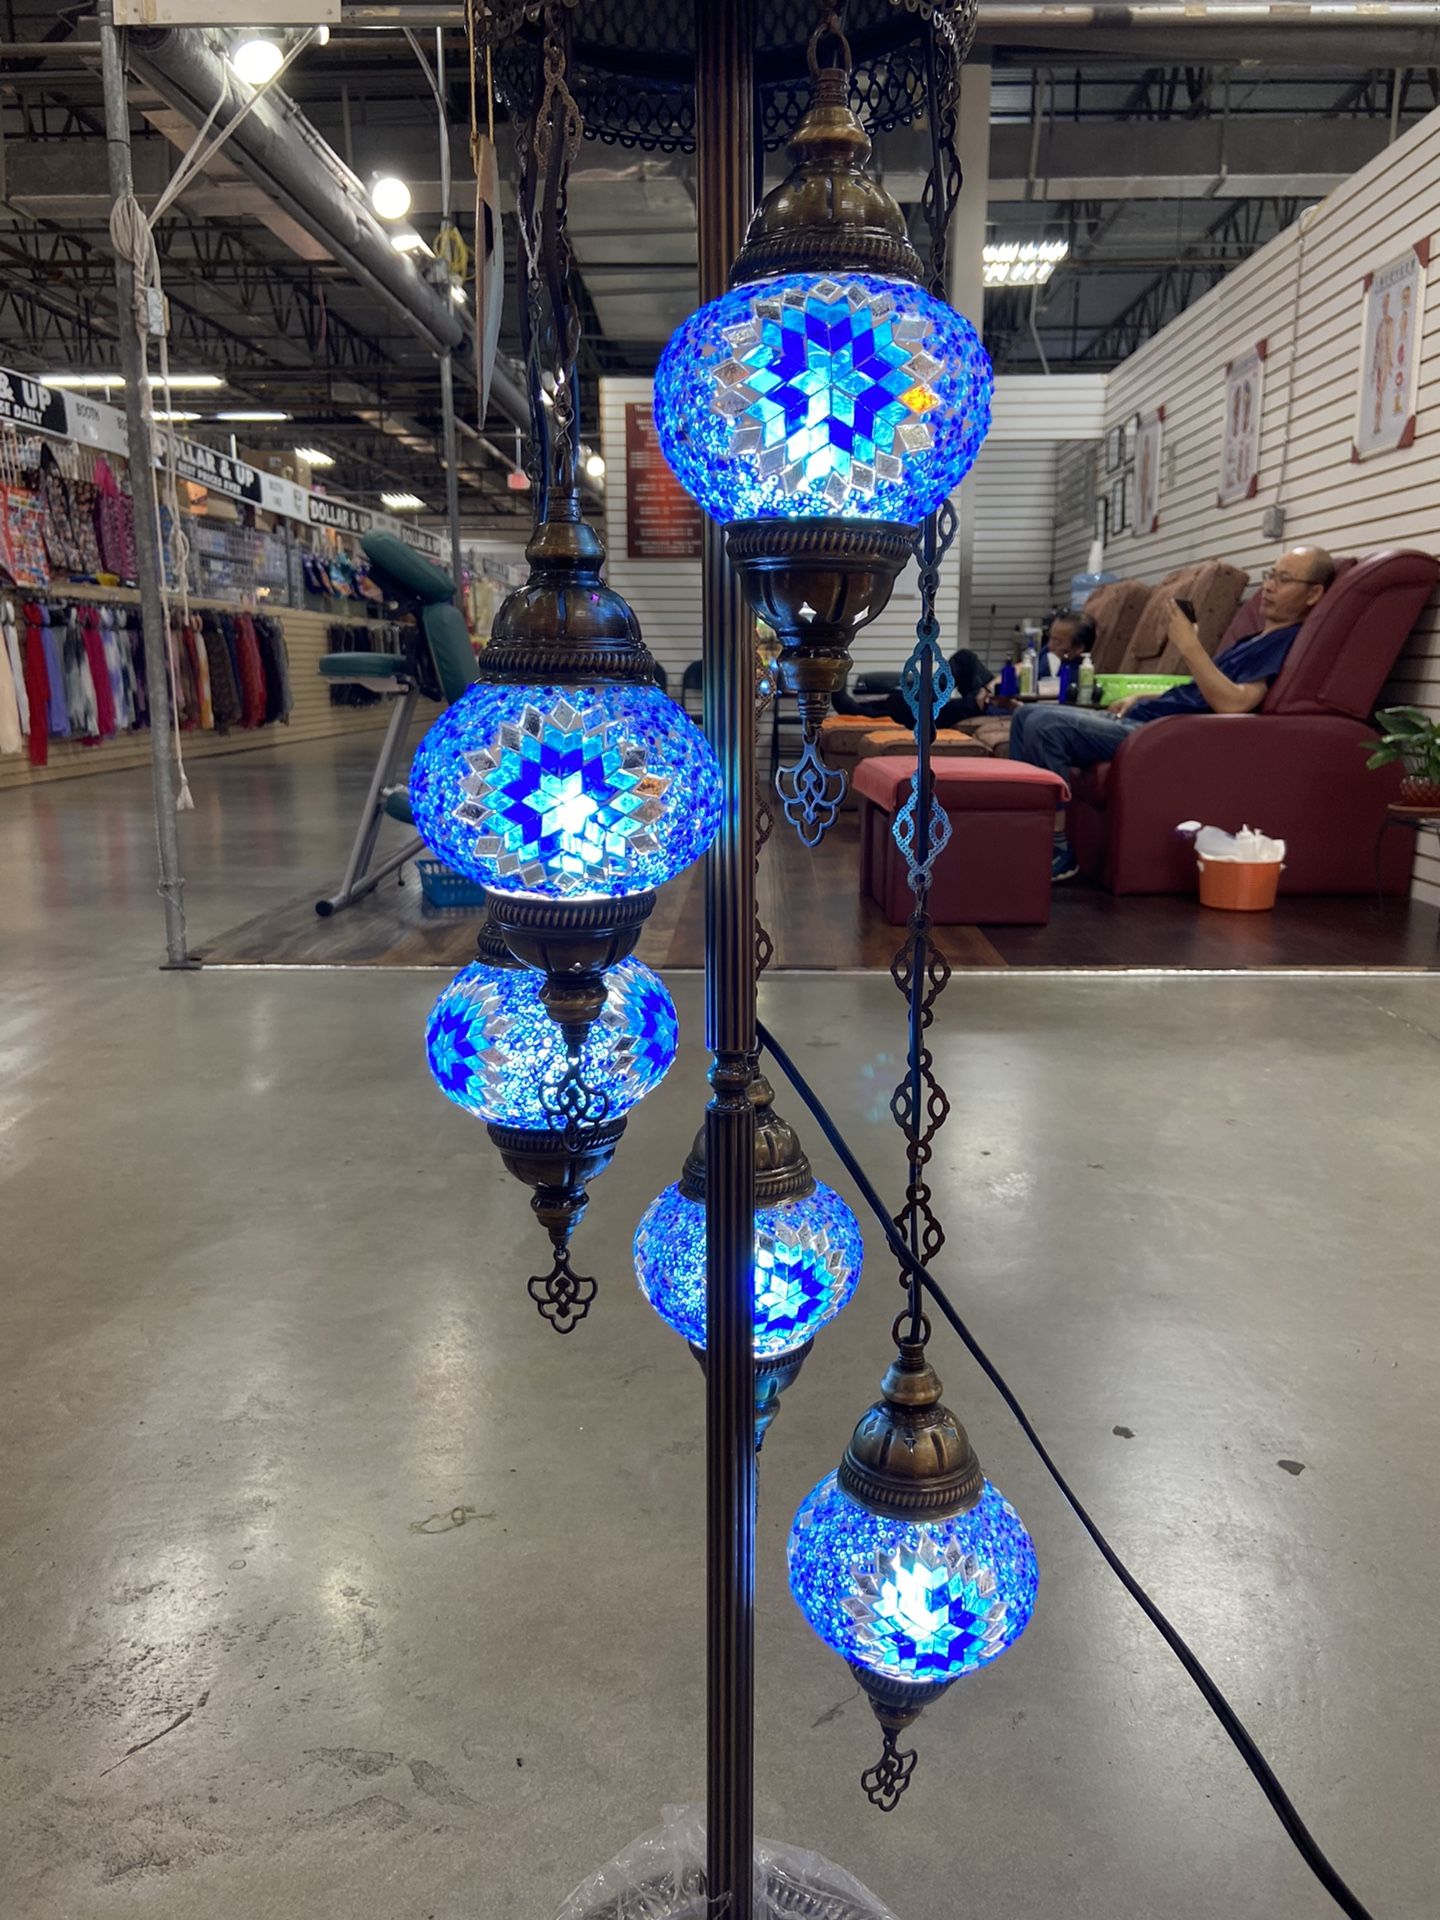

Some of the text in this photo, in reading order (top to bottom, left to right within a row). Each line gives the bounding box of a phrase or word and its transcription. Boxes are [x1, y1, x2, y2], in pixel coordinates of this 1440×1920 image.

[21, 380, 52, 412] UP
[13, 404, 43, 425] DAILY
[197, 469, 222, 488] PRICES
[220, 457, 232, 480] &
[235, 463, 254, 488] UP
[310, 499, 350, 526] DOLLAR
[351, 512, 359, 530] &
